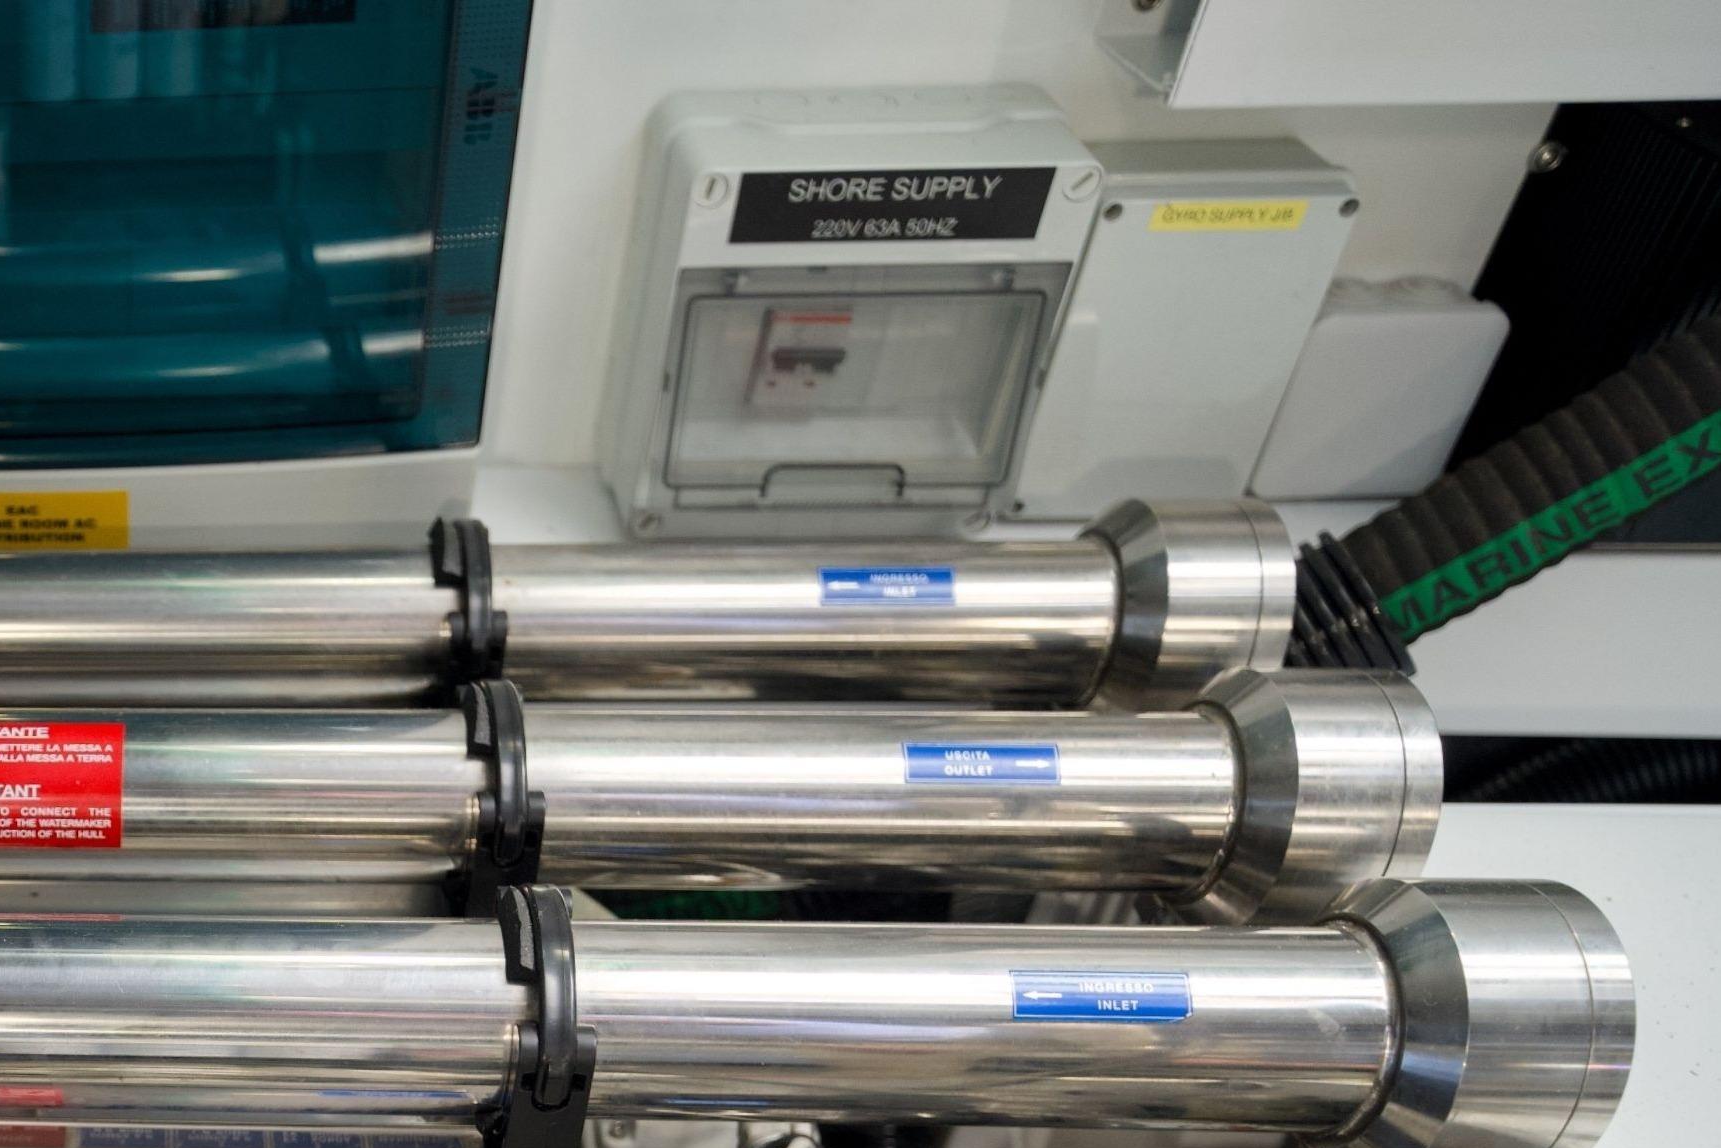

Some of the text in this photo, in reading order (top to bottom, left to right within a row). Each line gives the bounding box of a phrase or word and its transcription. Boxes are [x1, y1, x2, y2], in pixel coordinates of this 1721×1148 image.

[788, 176, 1003, 201] SHORE SUPPLY
[811, 217, 959, 238] 220V 63A 50HZ
[19, 518, 69, 529] ROOM
[870, 573, 928, 584] INGRESSO
[46, 743, 60, 752] LA
[62, 743, 102, 752] MESSA
[104, 743, 113, 752] A
[26, 753, 64, 763] MESSA
[66, 753, 75, 763] A
[76, 754, 112, 763] TERRA
[944, 750, 991, 761] USCITA
[944, 765, 993, 776] OUTLET
[20, 806, 77, 817] CONNECT
[89, 806, 112, 817] THE
[16, 818, 37, 828] THE
[38, 818, 112, 829] WATERMAKER
[38, 829, 53, 839] OF
[55, 829, 76, 839] THE
[77, 829, 106, 839] HULL
[1078, 982, 1154, 993] INGRESSO
[1097, 1000, 1139, 1010] INLET
